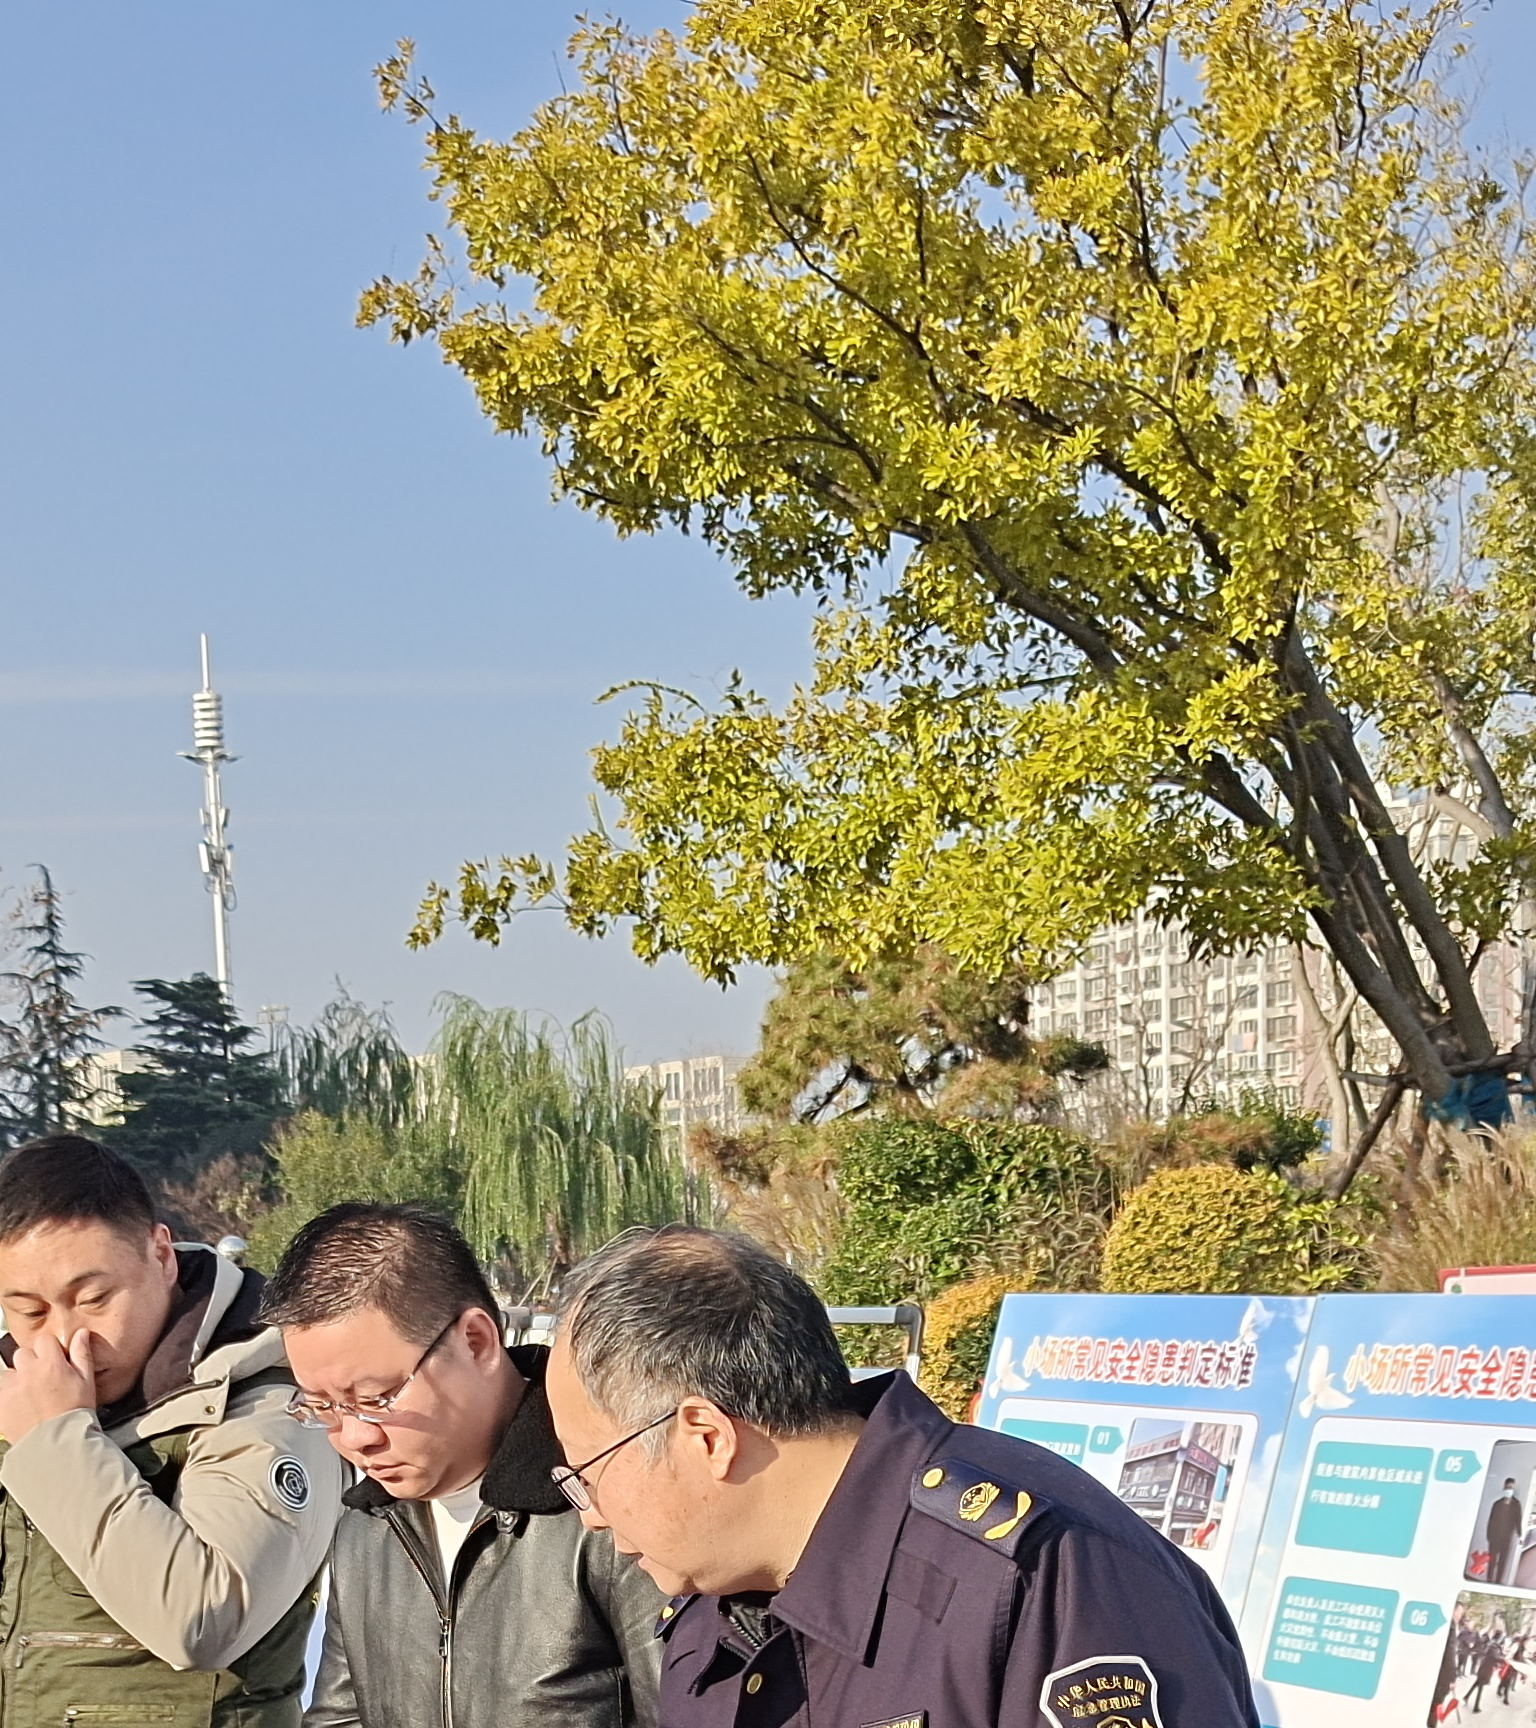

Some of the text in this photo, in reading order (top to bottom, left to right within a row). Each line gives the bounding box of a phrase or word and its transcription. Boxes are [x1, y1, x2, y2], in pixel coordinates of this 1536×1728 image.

[1024, 1337, 1257, 1389] 小场所常见安全隐患判定标准
[1096, 1431, 1111, 1446] 01
[1443, 1456, 1463, 1473] 05
[1410, 1608, 1428, 1627] 06
